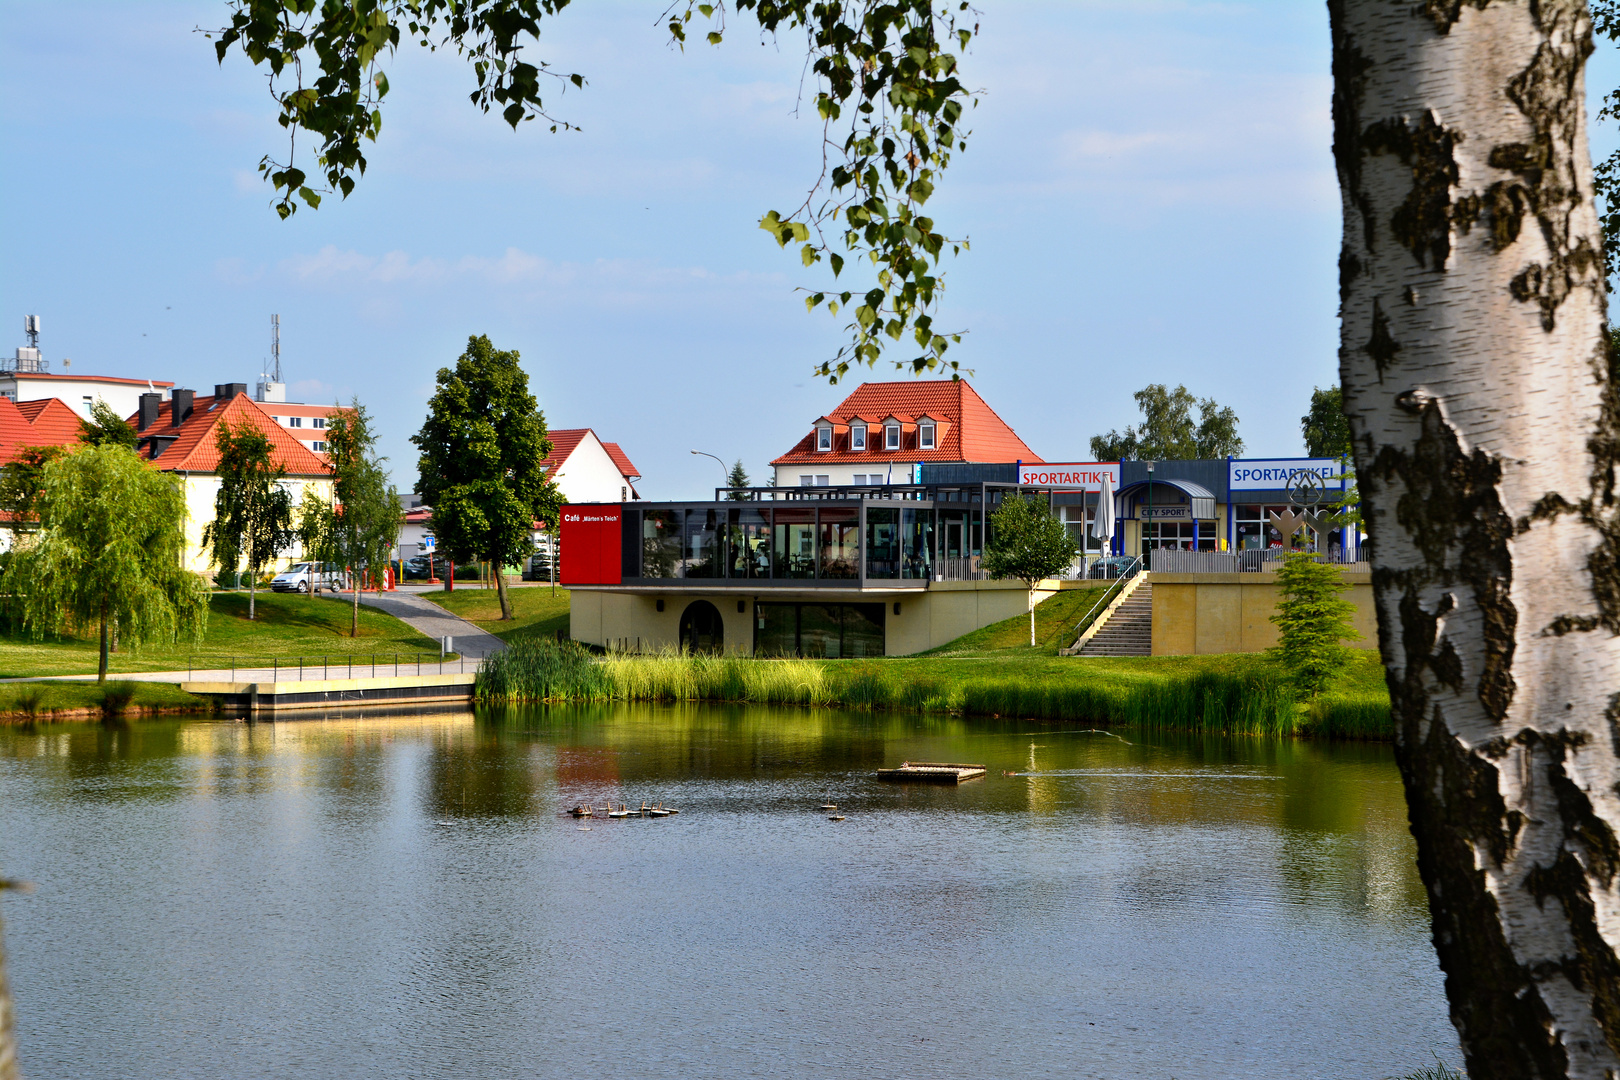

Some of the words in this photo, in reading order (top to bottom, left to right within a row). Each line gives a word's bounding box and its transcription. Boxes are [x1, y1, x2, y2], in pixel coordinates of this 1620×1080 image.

[1023, 471, 1116, 485] SPORTARTIKL
[1234, 467, 1336, 481] SPORTARTIKEL
[564, 514, 580, 522] Café
